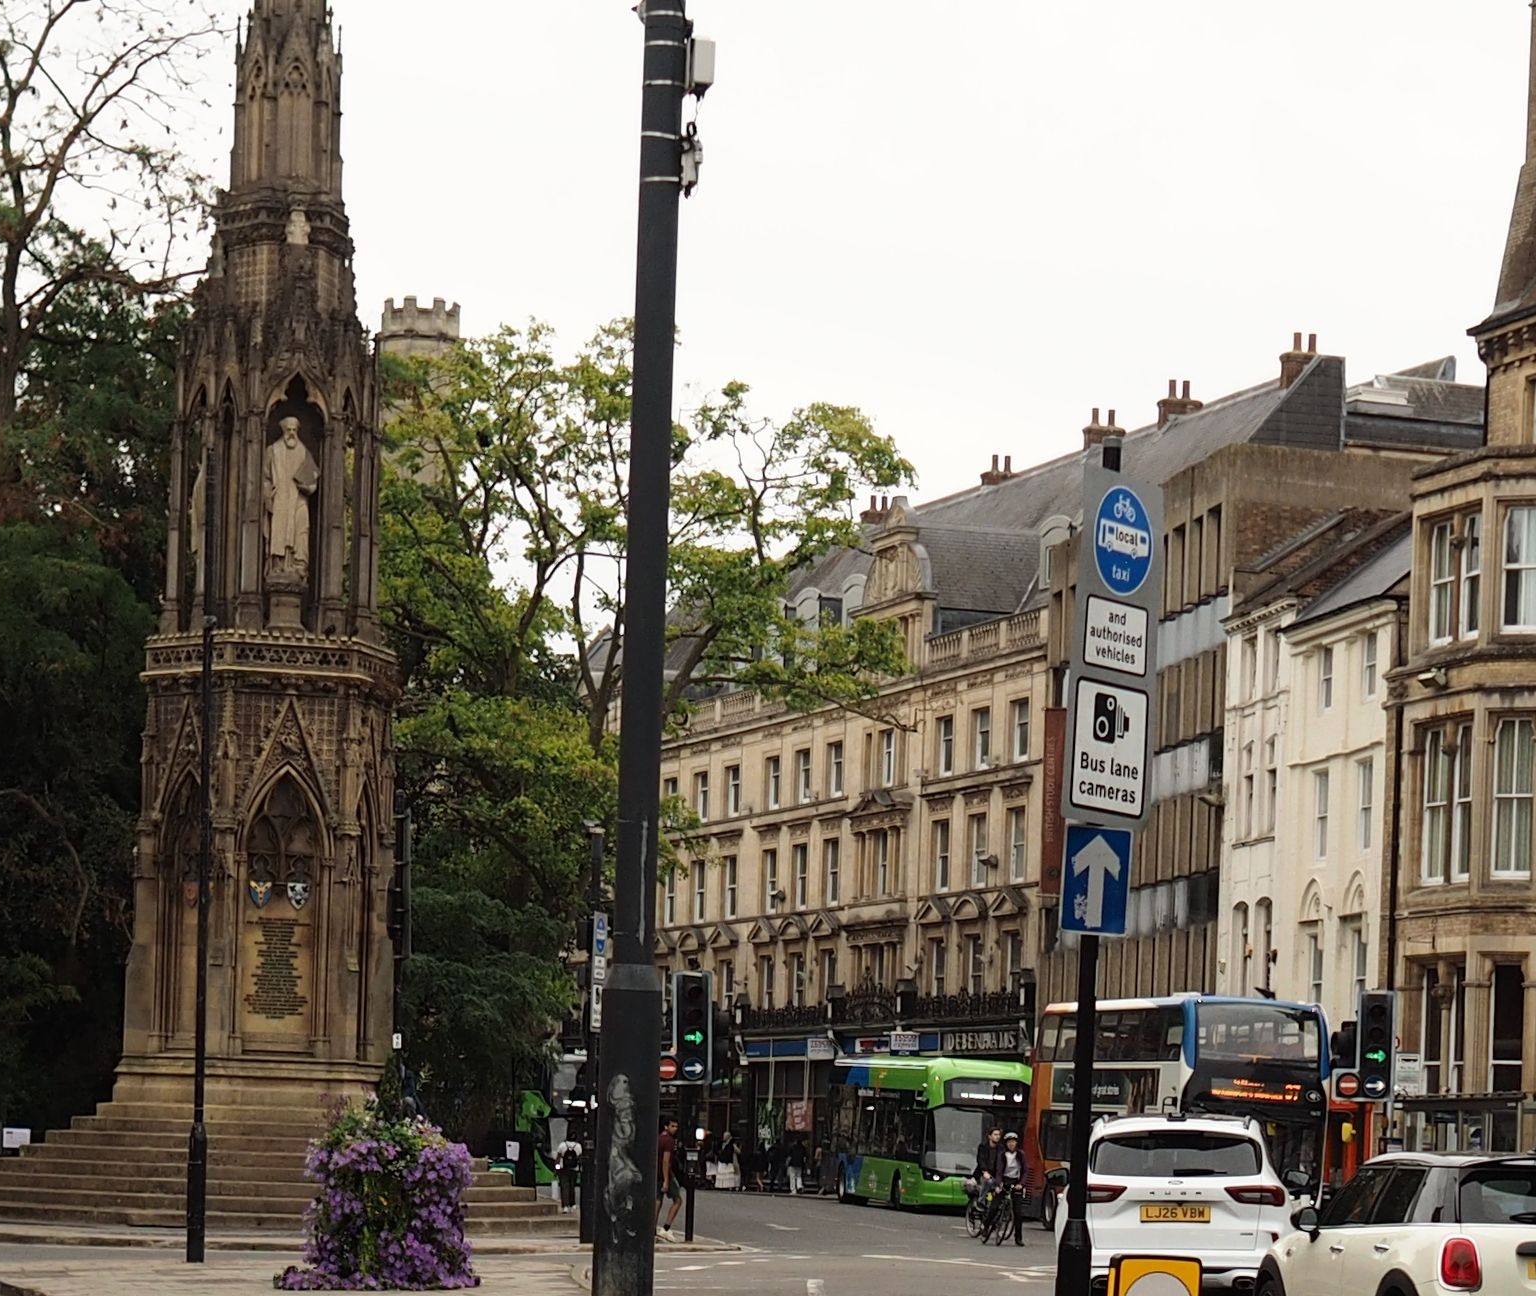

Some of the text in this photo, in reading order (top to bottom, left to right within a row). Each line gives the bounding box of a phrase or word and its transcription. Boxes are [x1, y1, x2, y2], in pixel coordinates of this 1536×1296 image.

[1115, 528, 1138, 546] local
[1112, 564, 1131, 582] taxi
[1108, 610, 1127, 626] and
[1090, 625, 1143, 648] authorised
[1095, 644, 1136, 665] vehicles
[1080, 751, 1139, 780] Bus lane
[1079, 780, 1136, 804] cameras
[947, 1031, 1017, 1050] DEBENHAMS
[1146, 1207, 1205, 1218] LJ26 VBW
